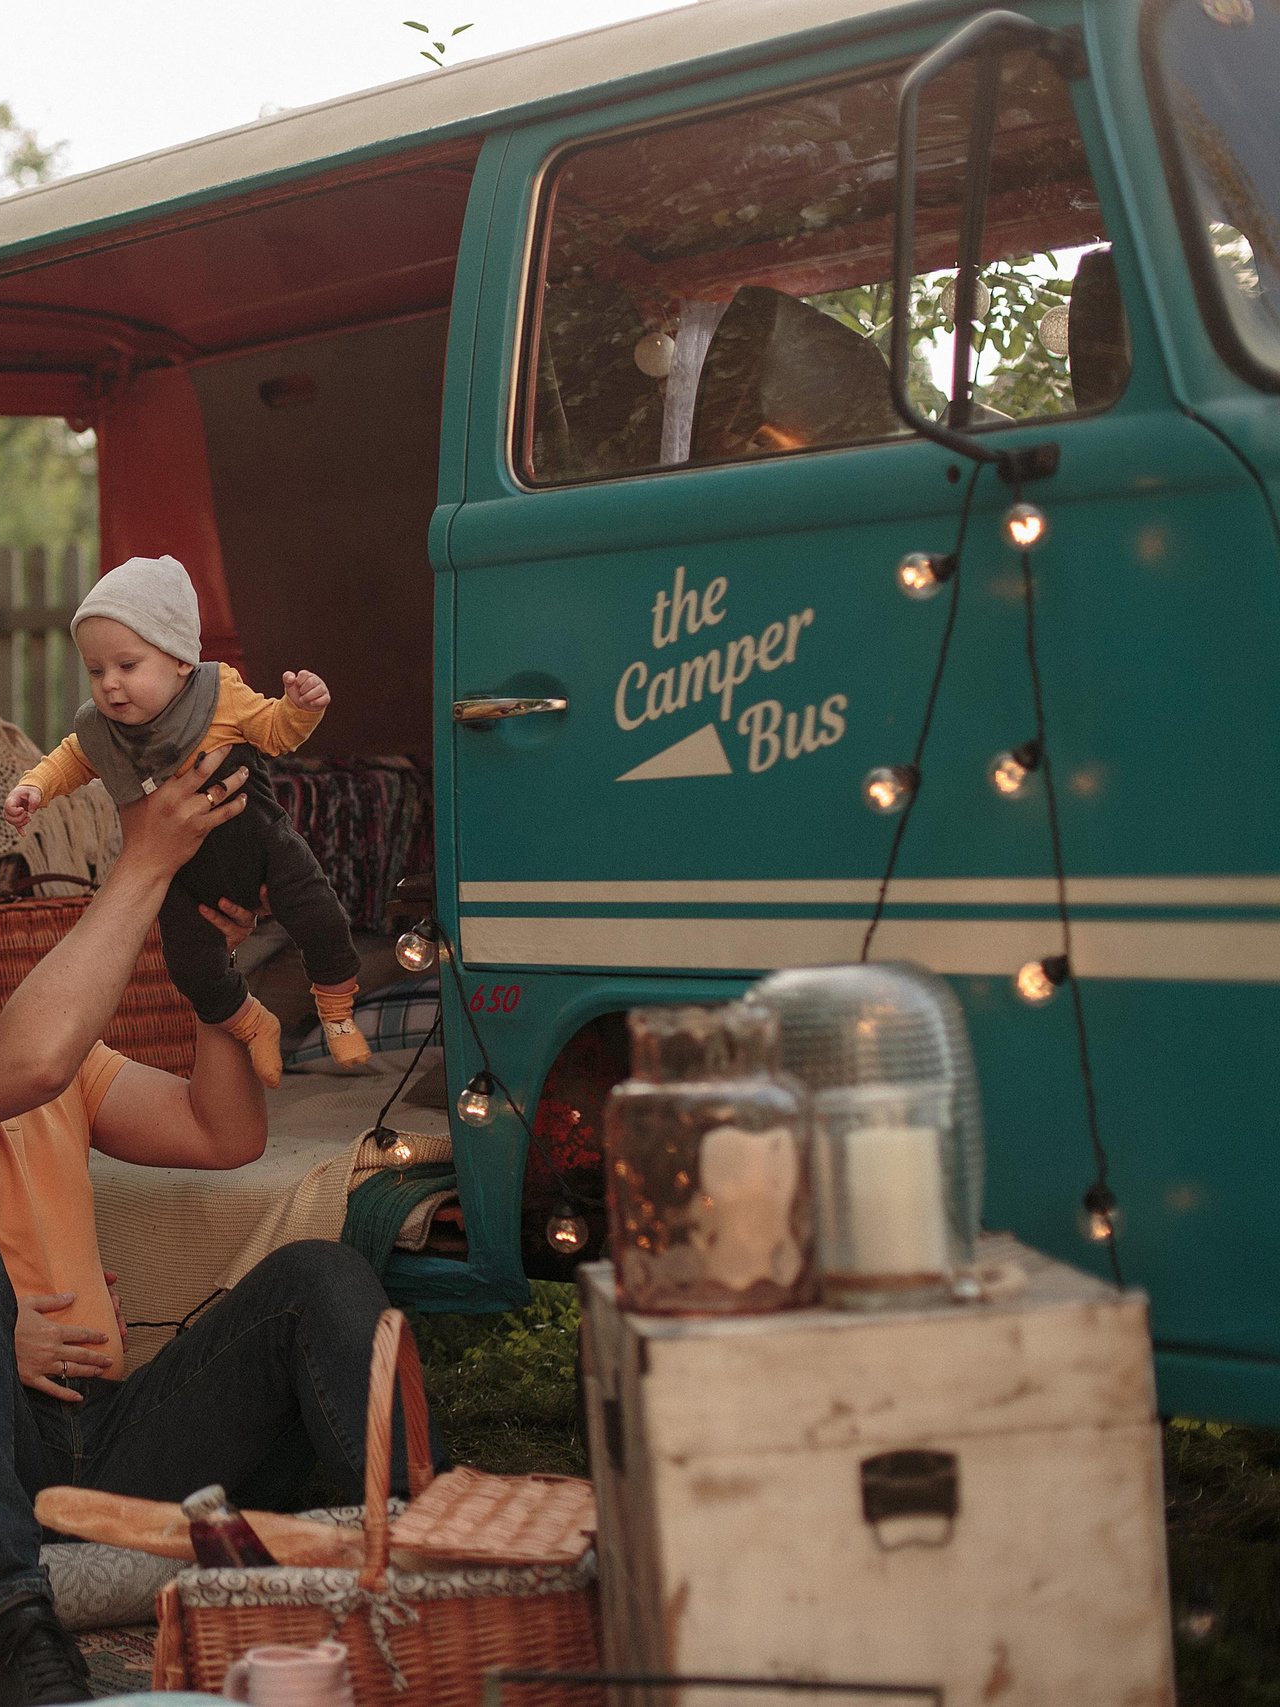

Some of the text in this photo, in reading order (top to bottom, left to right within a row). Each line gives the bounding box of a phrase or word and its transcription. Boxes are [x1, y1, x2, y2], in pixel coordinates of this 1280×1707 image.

[651, 565, 729, 650] the
[613, 606, 816, 732] Camper
[736, 693, 850, 774] Bus
[469, 984, 521, 1014] 650
